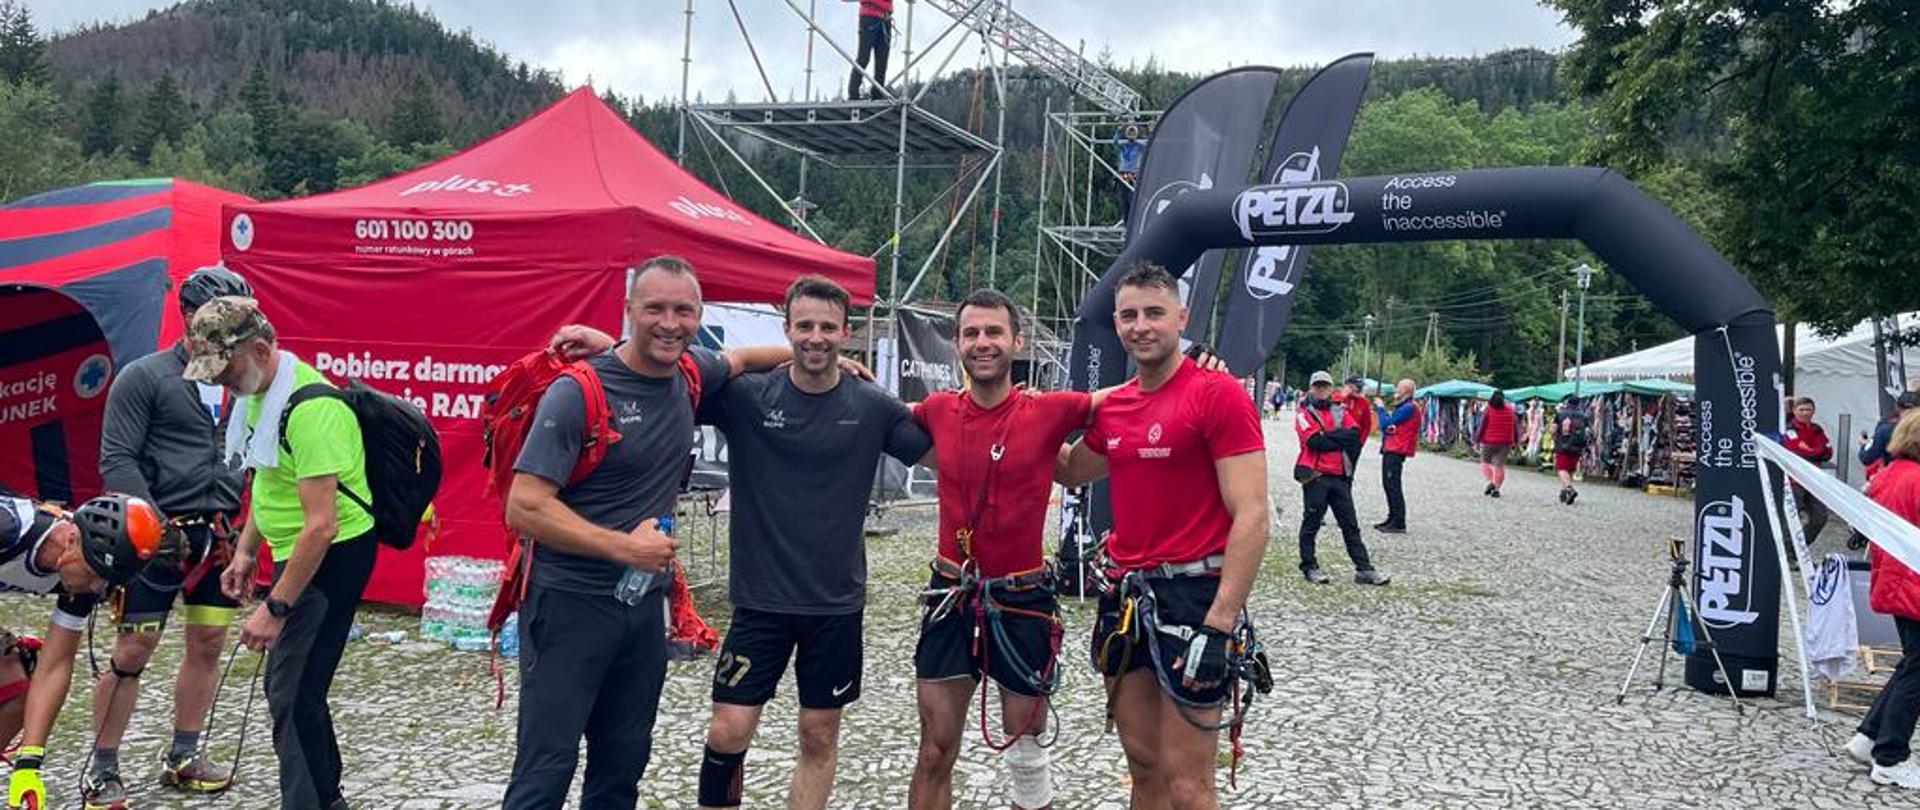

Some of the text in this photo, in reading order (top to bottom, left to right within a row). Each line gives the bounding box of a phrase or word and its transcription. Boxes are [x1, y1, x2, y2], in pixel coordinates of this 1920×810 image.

[1384, 174, 1457, 190] Access
[1238, 186, 1355, 242] PETZL
[1383, 192, 1412, 210] the
[355, 219, 474, 241] 601 100 300
[355, 245, 474, 257] numer ratunkowy w górach
[315, 351, 507, 384] Pobierz darmo
[1700, 400, 1713, 468] Access
[1714, 438, 1734, 468] the
[1700, 495, 1760, 624] PETZL
[716, 651, 752, 687] 27
